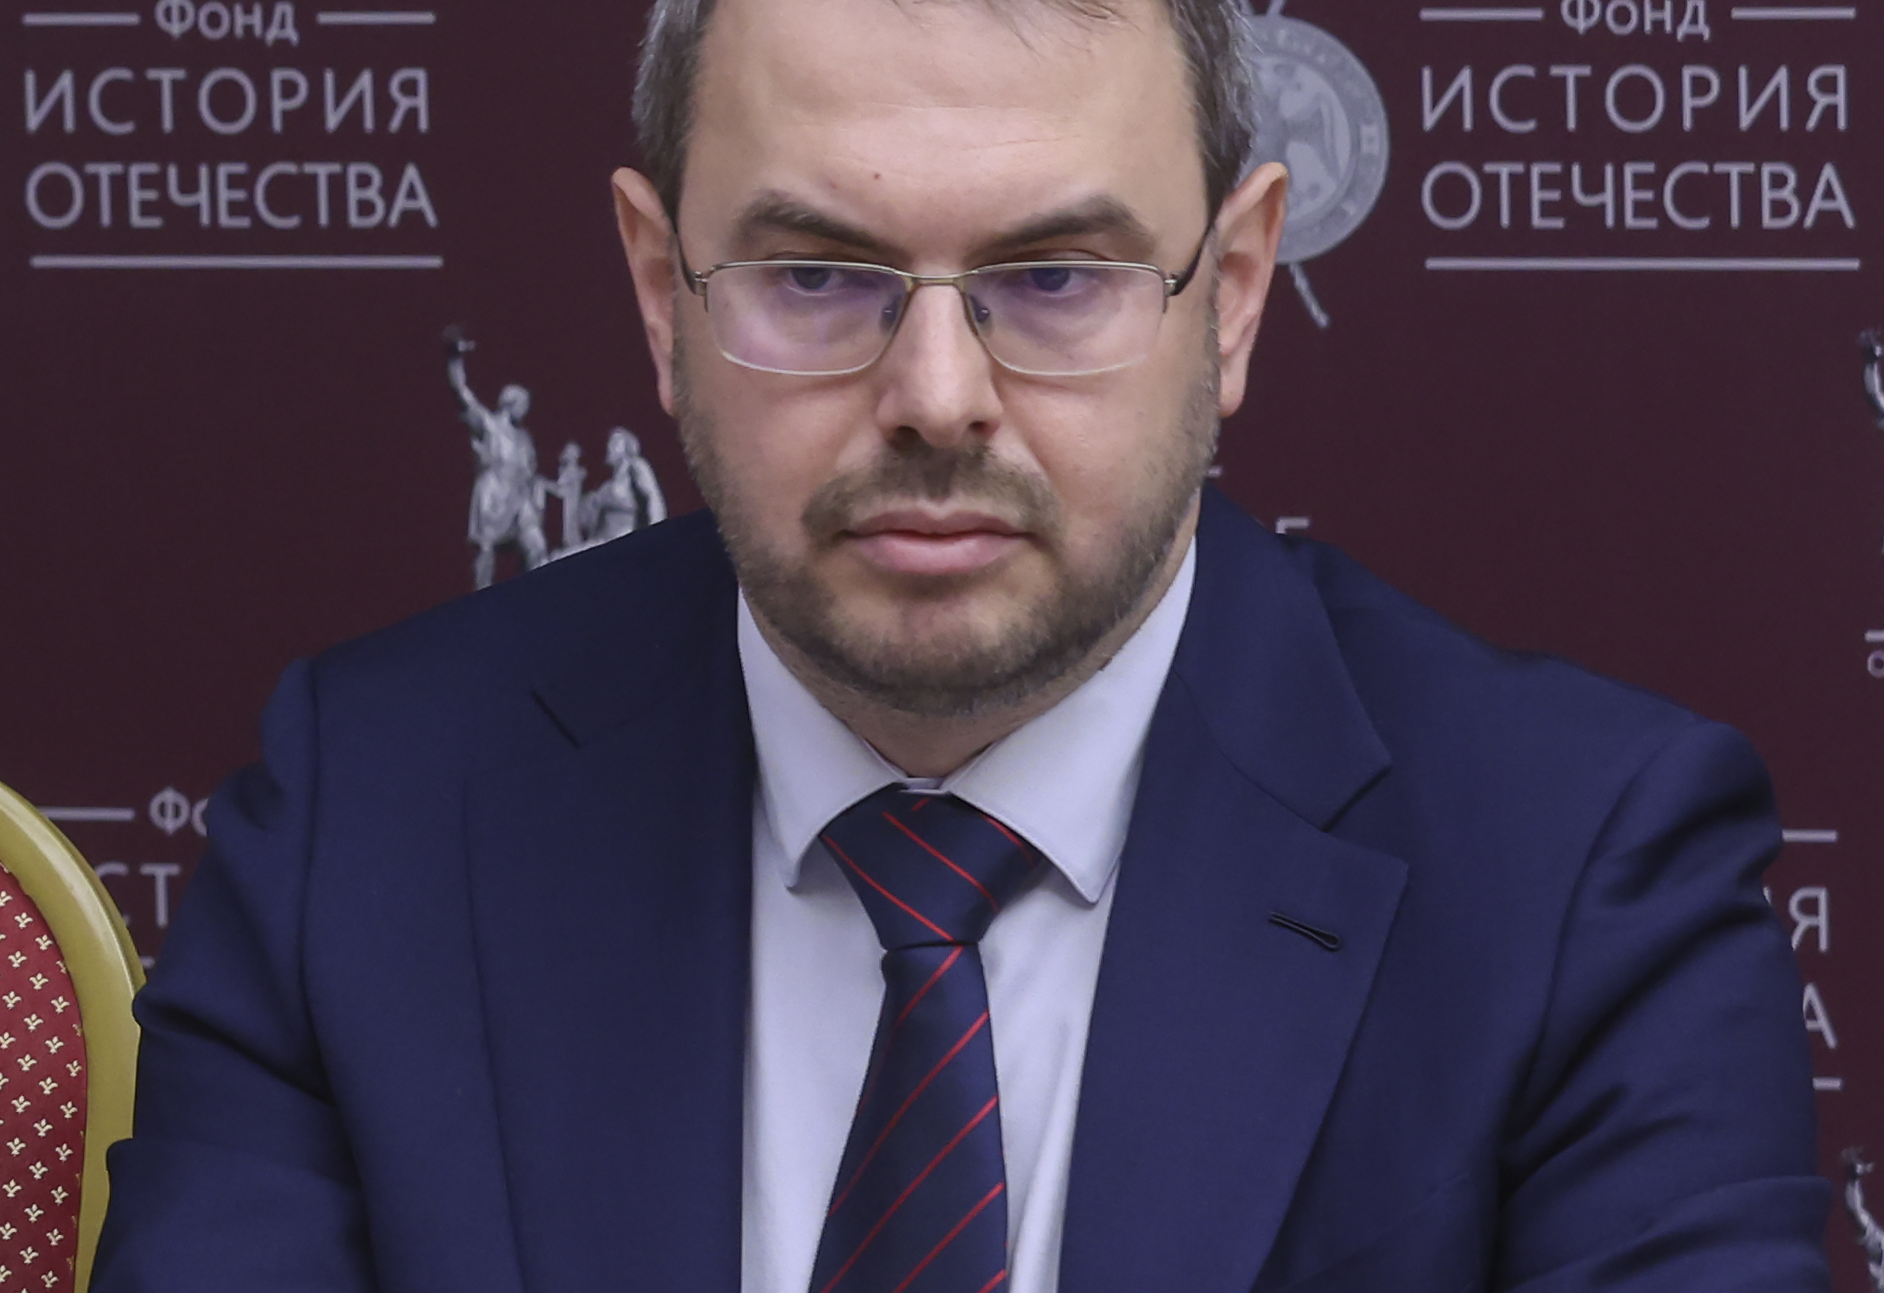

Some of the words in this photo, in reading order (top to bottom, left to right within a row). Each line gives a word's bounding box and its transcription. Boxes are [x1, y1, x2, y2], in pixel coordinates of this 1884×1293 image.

[24, 67, 431, 137] ИСТОРИЯ
[1422, 64, 1849, 135] ИСТОРИЯ
[26, 162, 440, 231] ОТЕЧЕСТВА
[1421, 161, 1857, 231] ОТЕЧЕСТВА
